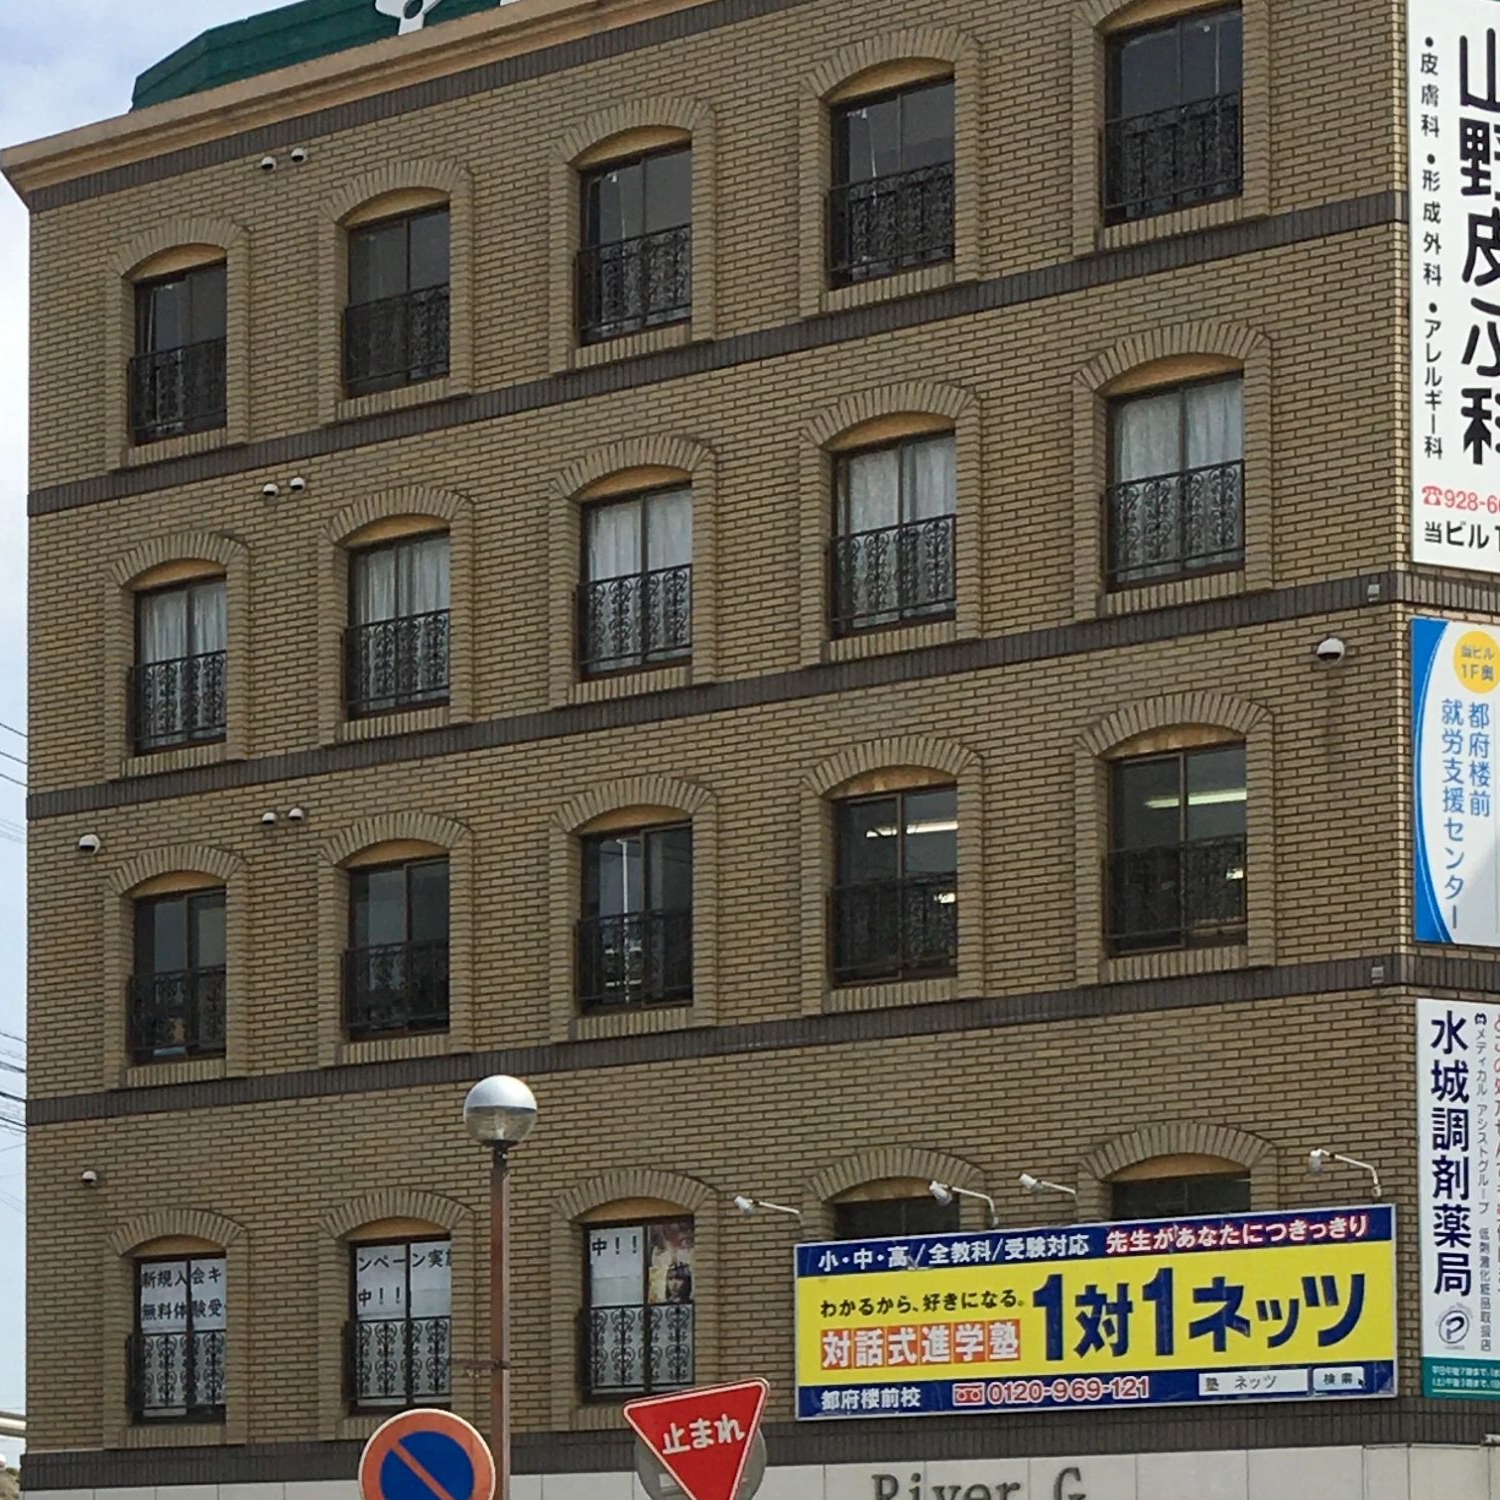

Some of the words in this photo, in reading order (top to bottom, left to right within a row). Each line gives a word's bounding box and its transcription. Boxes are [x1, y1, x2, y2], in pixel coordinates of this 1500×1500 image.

[1444, 489, 1500, 514] 928-6
[1468, 701, 1491, 818] 都府楼前
[1441, 697, 1466, 930] 就労支援センター
[1430, 1010, 1472, 1297] 水城調剤薬局
[1106, 1215, 1368, 1254] 先生があなたにつきっきり
[820, 1289, 1025, 1318] わかるから、好きになる。
[1032, 1266, 1366, 1361] 1対1ネッツ
[822, 1321, 1020, 1369] 対話式進学塾
[820, 1386, 921, 1411] 都府楼前校
[986, 1376, 1150, 1404] 0120-969-121
[661, 1412, 746, 1455] 止まれ
